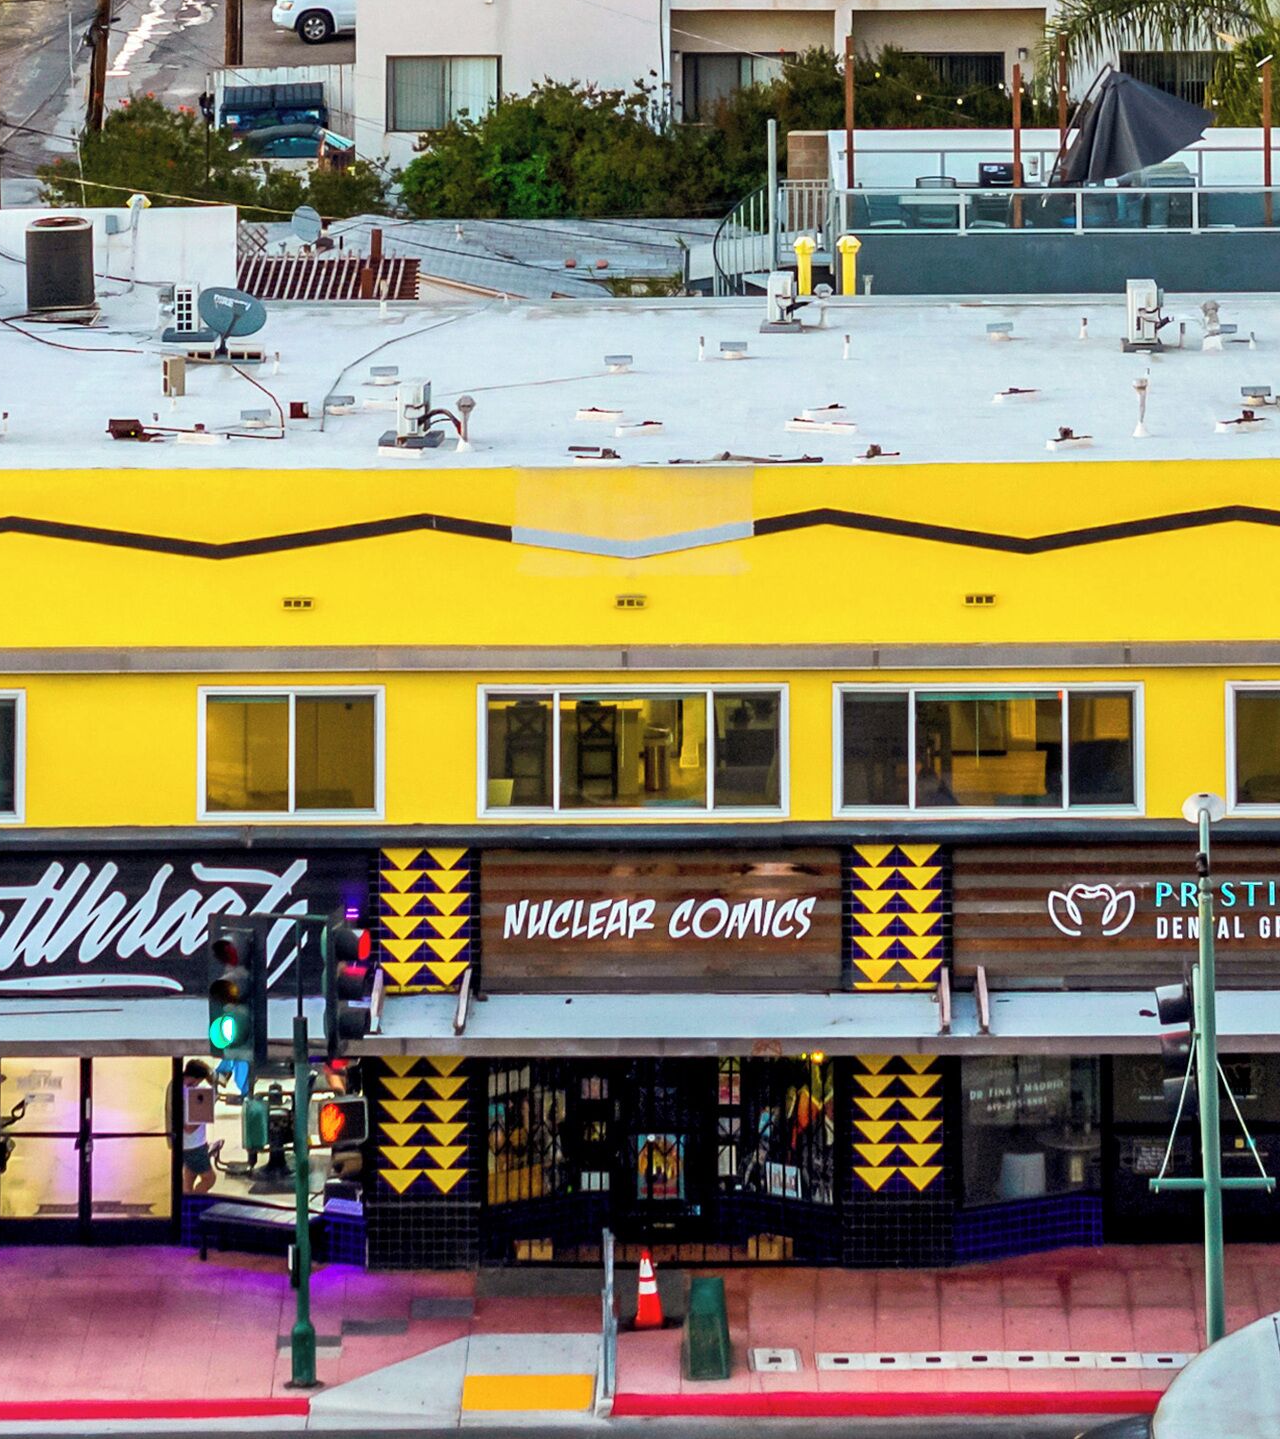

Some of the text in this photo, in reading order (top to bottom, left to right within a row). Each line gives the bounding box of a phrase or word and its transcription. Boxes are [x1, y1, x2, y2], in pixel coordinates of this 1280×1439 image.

[503, 896, 817, 940] NUCLEAR COMICS
[1156, 915, 1245, 940] DENAL
